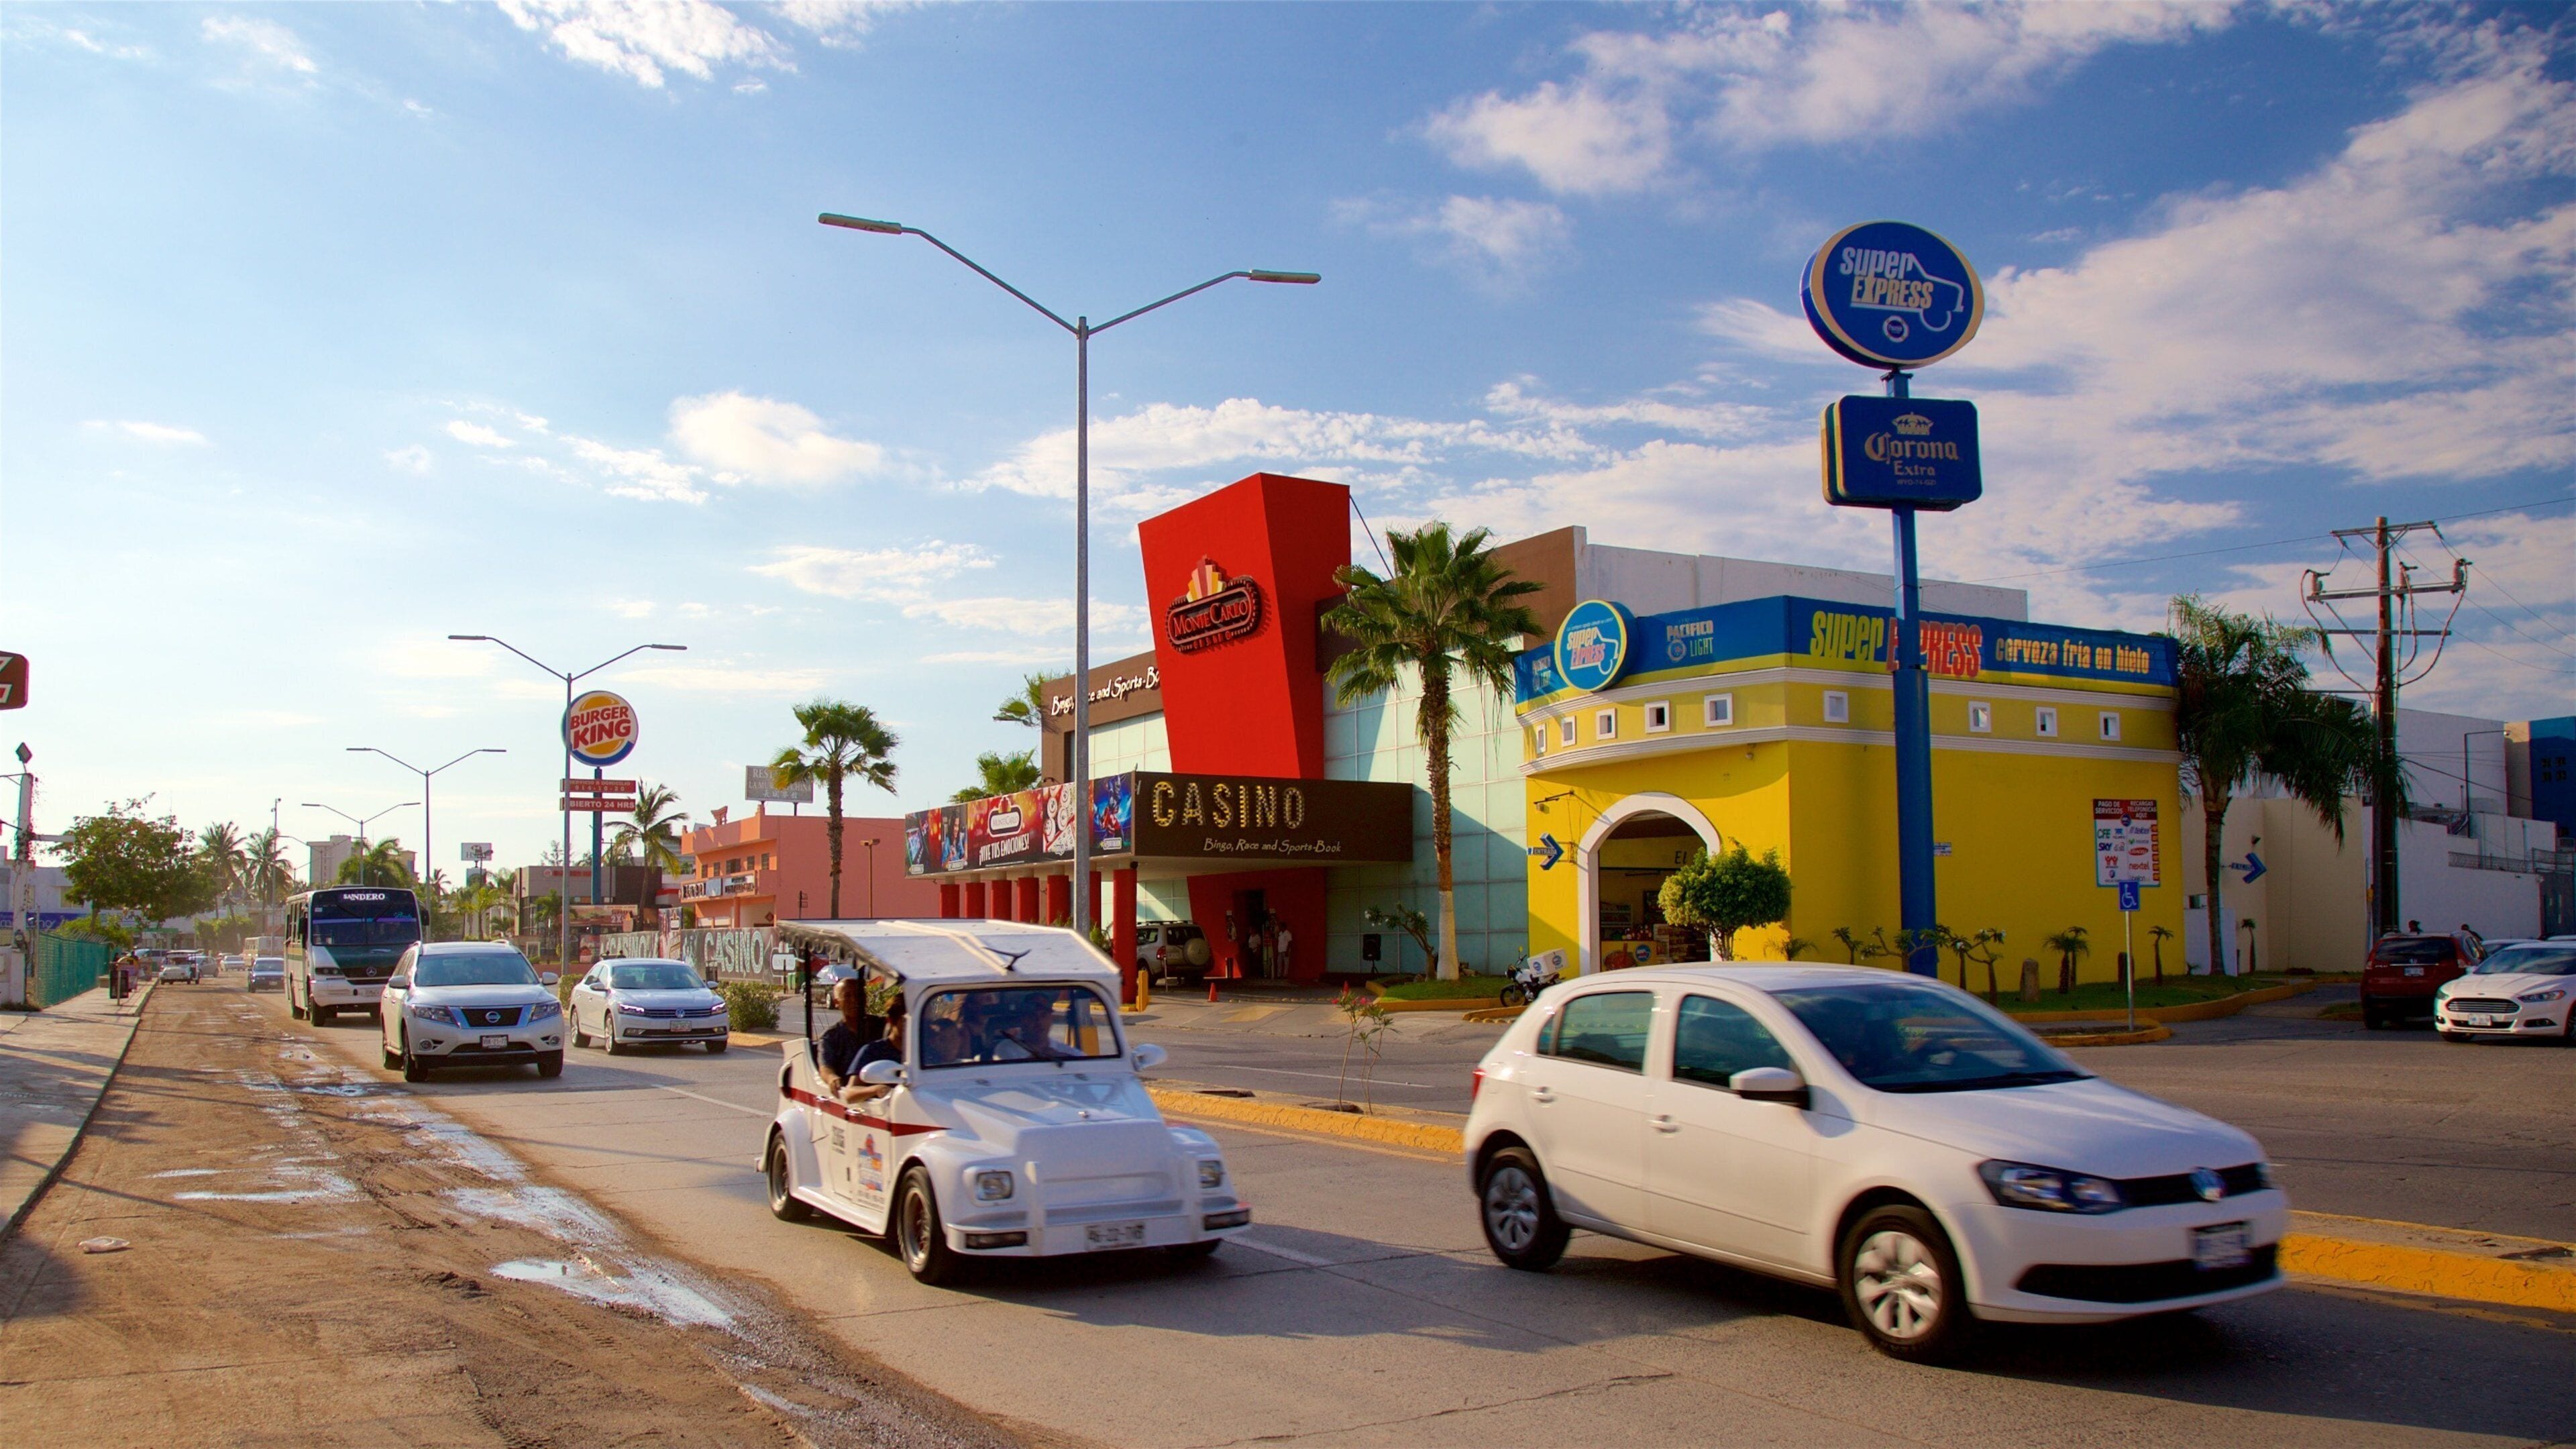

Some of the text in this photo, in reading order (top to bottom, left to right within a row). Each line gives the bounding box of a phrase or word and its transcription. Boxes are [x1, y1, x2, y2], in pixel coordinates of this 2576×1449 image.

[1851, 275, 1934, 309] EXPRESS
[1864, 432, 1960, 465] Corona
[1893, 460, 1935, 476] Extra
[1690, 637, 1713, 657] LIGHT
[1886, 616, 1982, 678] EPRESS
[2063, 639, 2091, 669] fría
[2096, 647, 2112, 670] en
[2116, 644, 2150, 674] hielo
[1096, 679, 1112, 700] and
[570, 706, 629, 730] BURGER
[572, 719, 631, 749] KING
[569, 800, 602, 808] BIERTO
[616, 801, 635, 809] HRS
[1152, 781, 1305, 829] CASINO
[991, 841, 1000, 859] TUS
[1203, 838, 1342, 855] Bingo, Race and Sports-Book
[2098, 843, 2112, 851] SKY
[704, 930, 763, 973] CASINO
